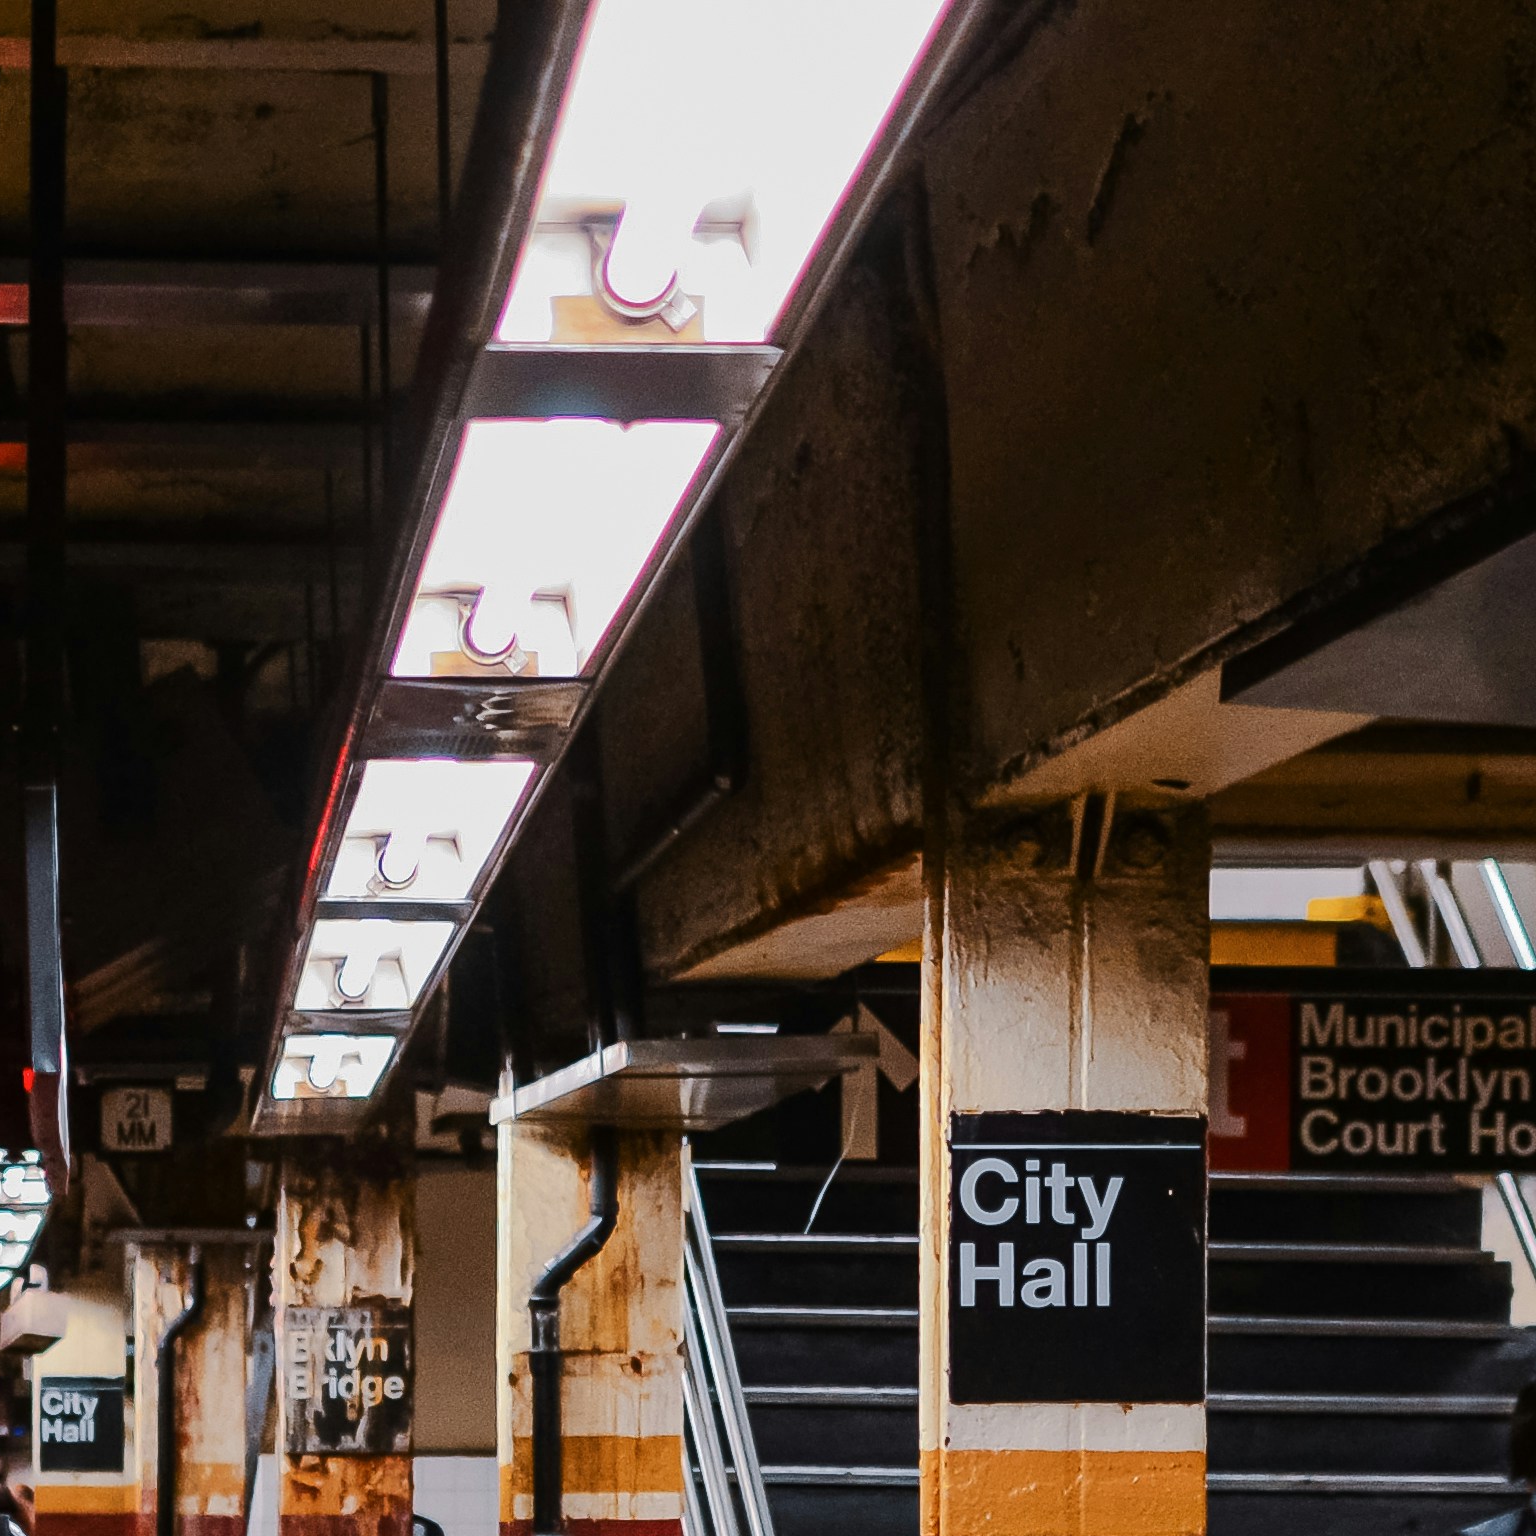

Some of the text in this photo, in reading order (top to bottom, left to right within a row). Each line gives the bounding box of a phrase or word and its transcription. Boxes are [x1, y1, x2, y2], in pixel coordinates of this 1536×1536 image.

[1300, 1055, 1530, 1111] Brooklyn
[116, 1121, 157, 1146] MM
[1300, 1108, 1447, 1156] Court
[959, 1157, 1124, 1240] City
[959, 1242, 1111, 1308] Hall
[41, 1387, 99, 1421] City
[41, 1418, 95, 1443] Hall
